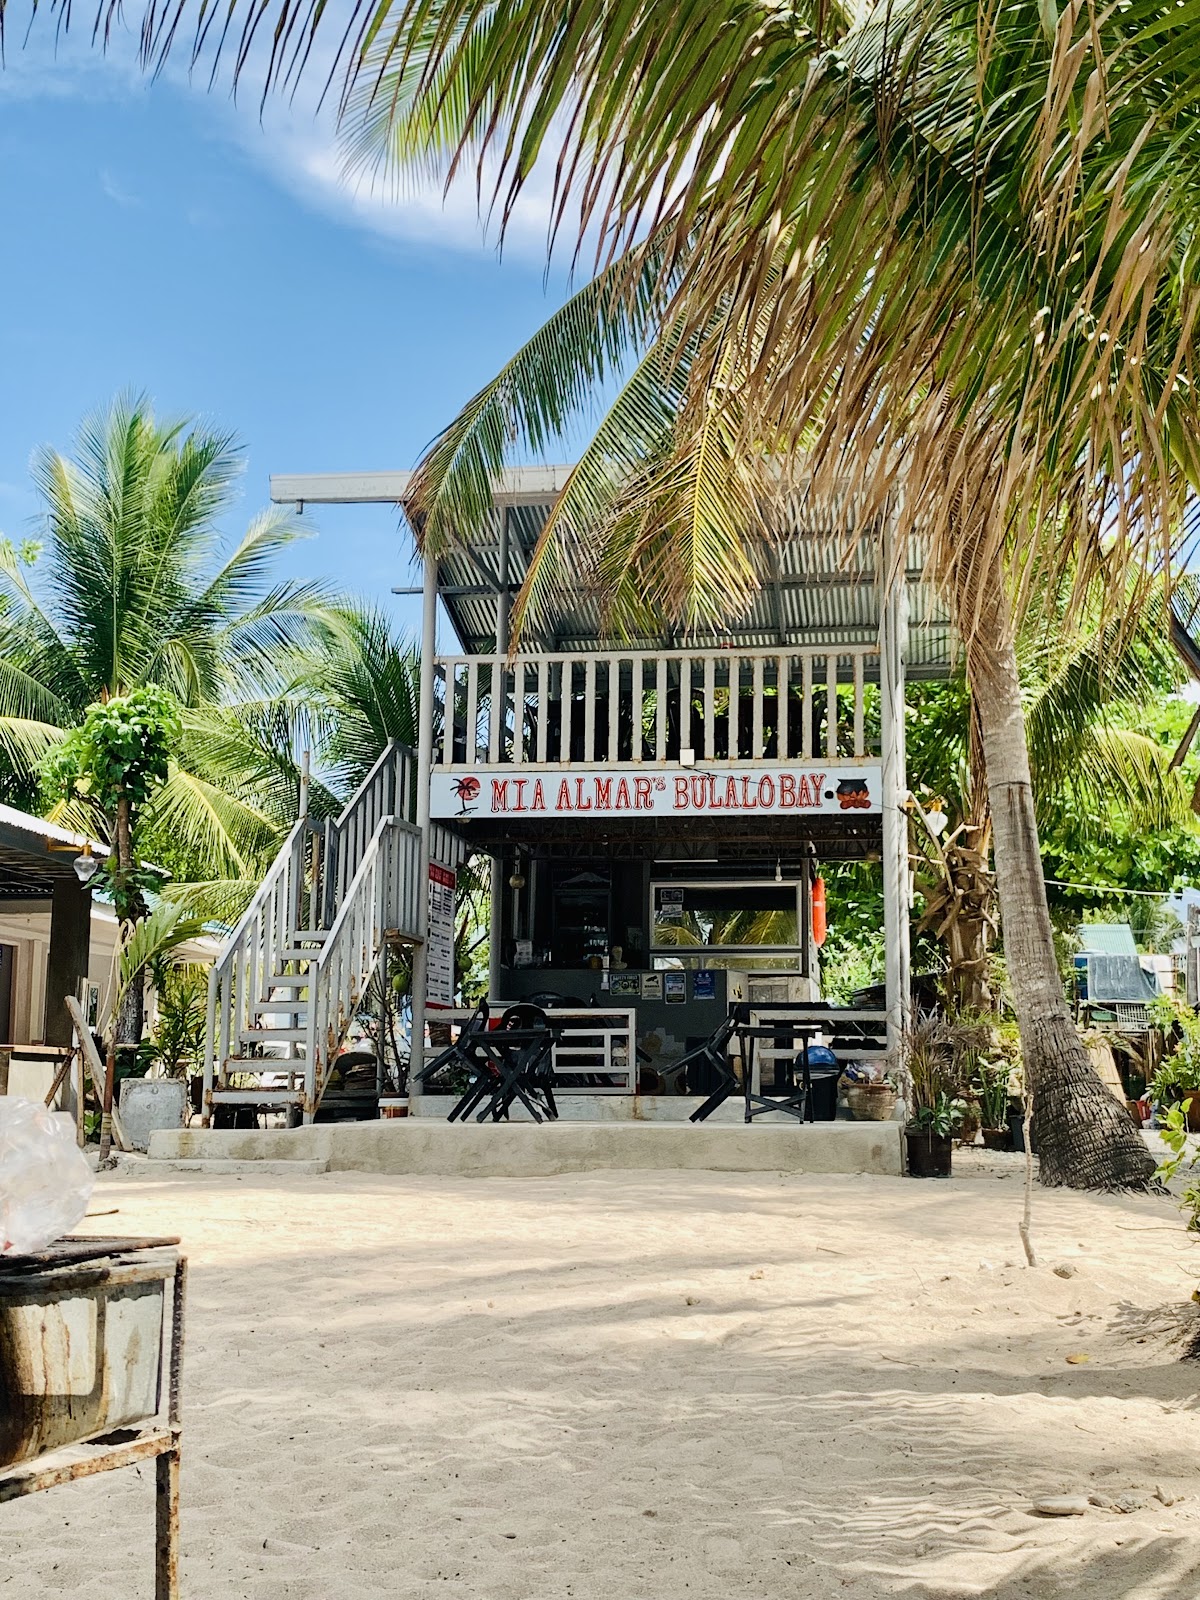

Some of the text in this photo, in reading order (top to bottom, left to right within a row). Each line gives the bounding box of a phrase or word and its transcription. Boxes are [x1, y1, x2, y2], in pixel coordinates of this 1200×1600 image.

[491, 778, 547, 813] MIA
[673, 774, 775, 810] BULALO
[778, 772, 827, 808] BAY
